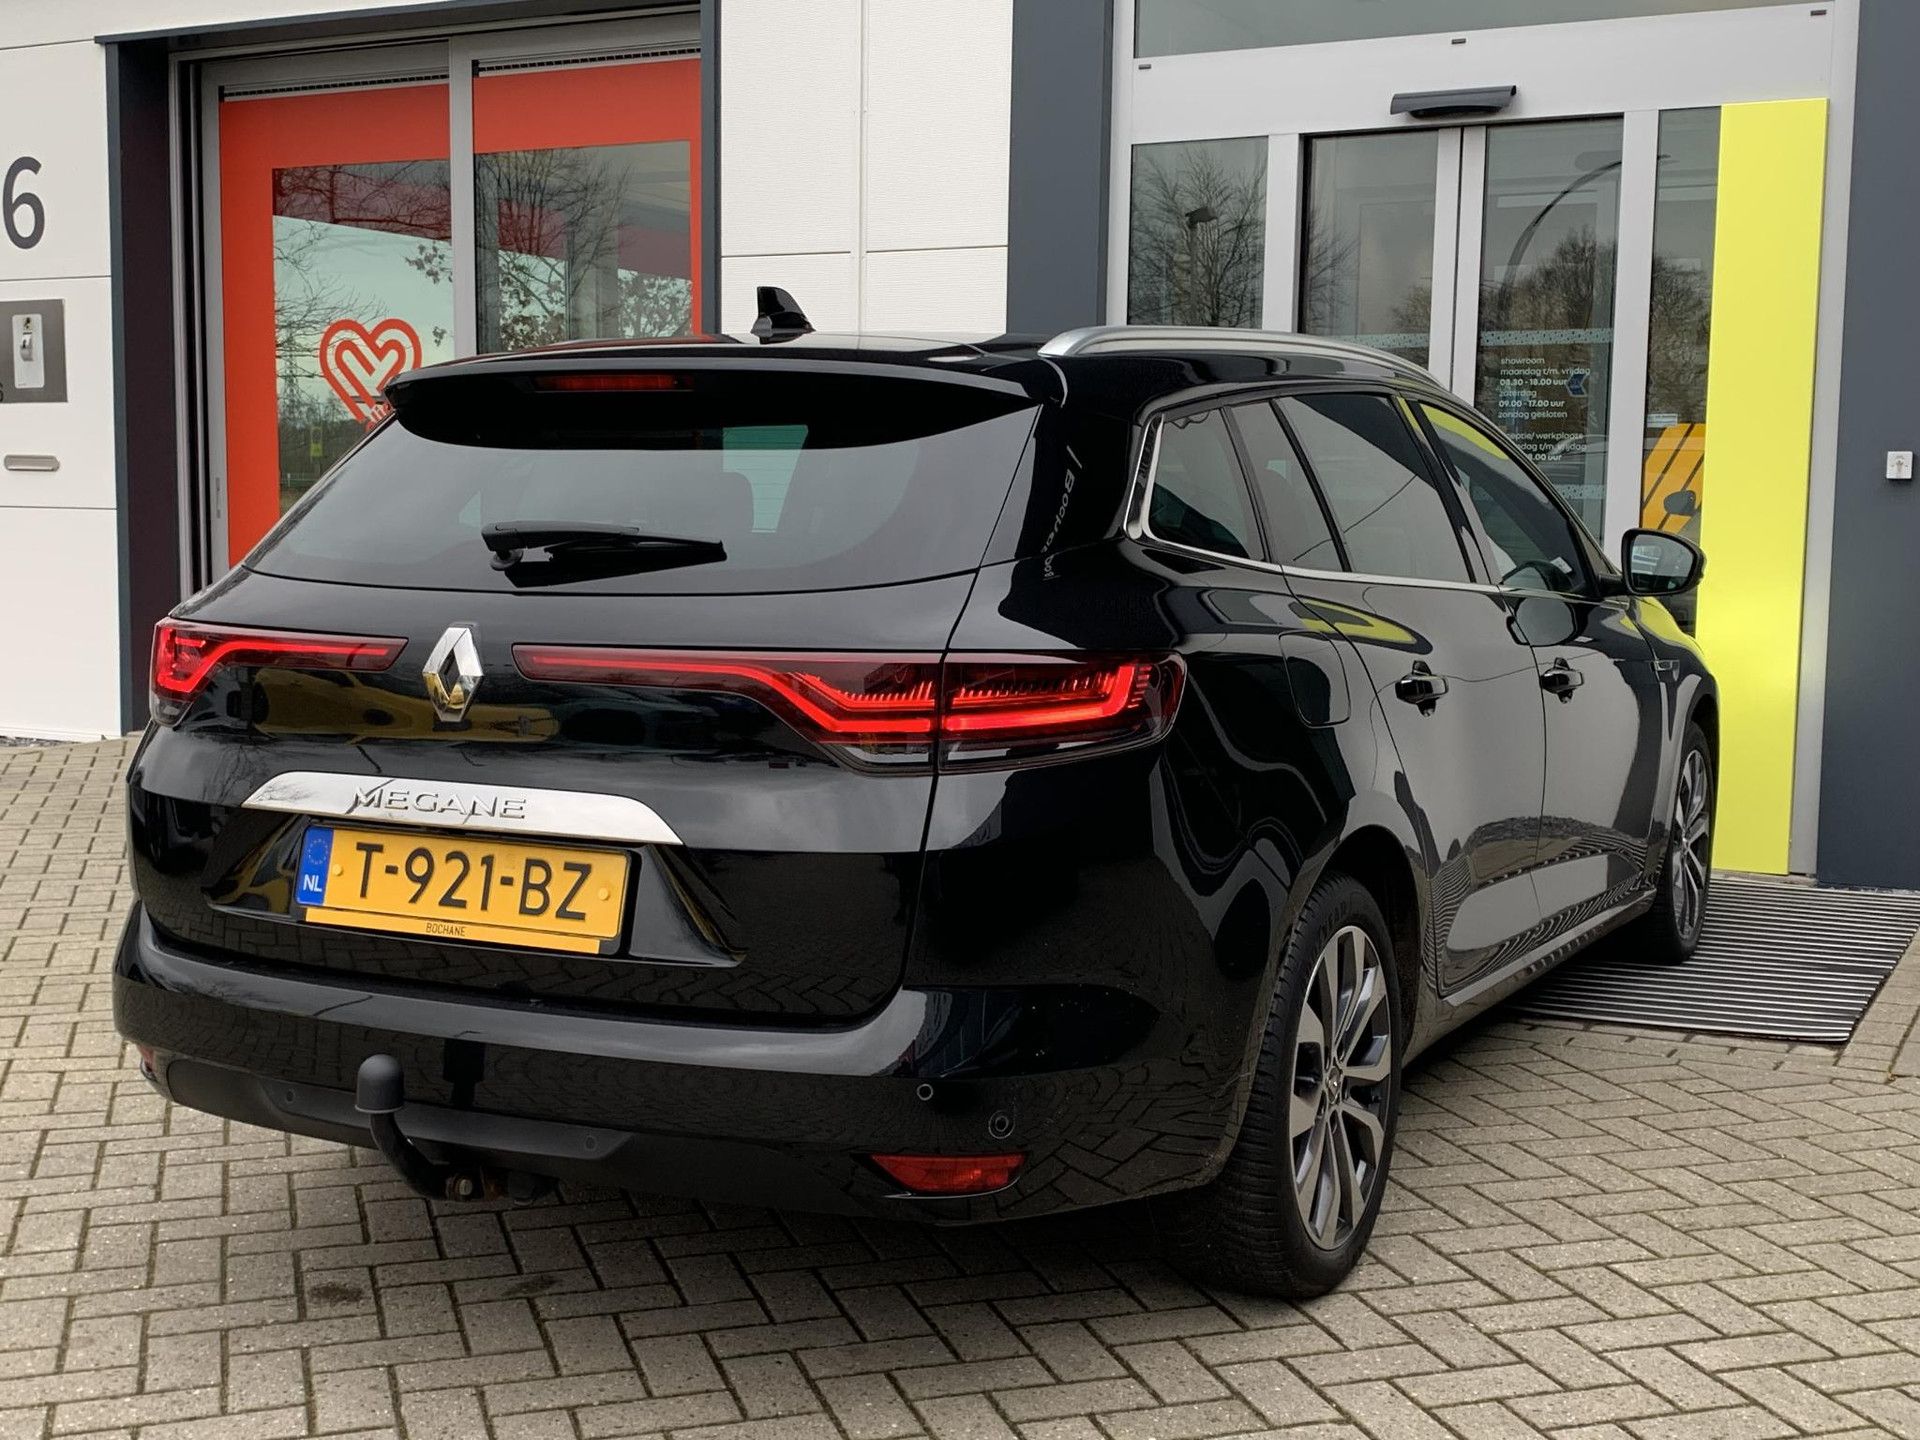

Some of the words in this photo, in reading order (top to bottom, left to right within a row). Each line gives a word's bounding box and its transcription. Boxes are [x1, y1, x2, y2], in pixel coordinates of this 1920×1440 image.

[3, 156, 45, 249] 6
[1500, 368, 1541, 377] maandag
[1561, 367, 1591, 376] vrijdag
[1499, 390, 1537, 398] zaterdag
[1498, 411, 1529, 419] zondag
[1531, 411, 1568, 419] gesloten
[352, 785, 527, 820] MEGANE
[303, 874, 323, 892] NL
[356, 842, 592, 921] T-921-BZ
[425, 922, 466, 937] BOCHANE
